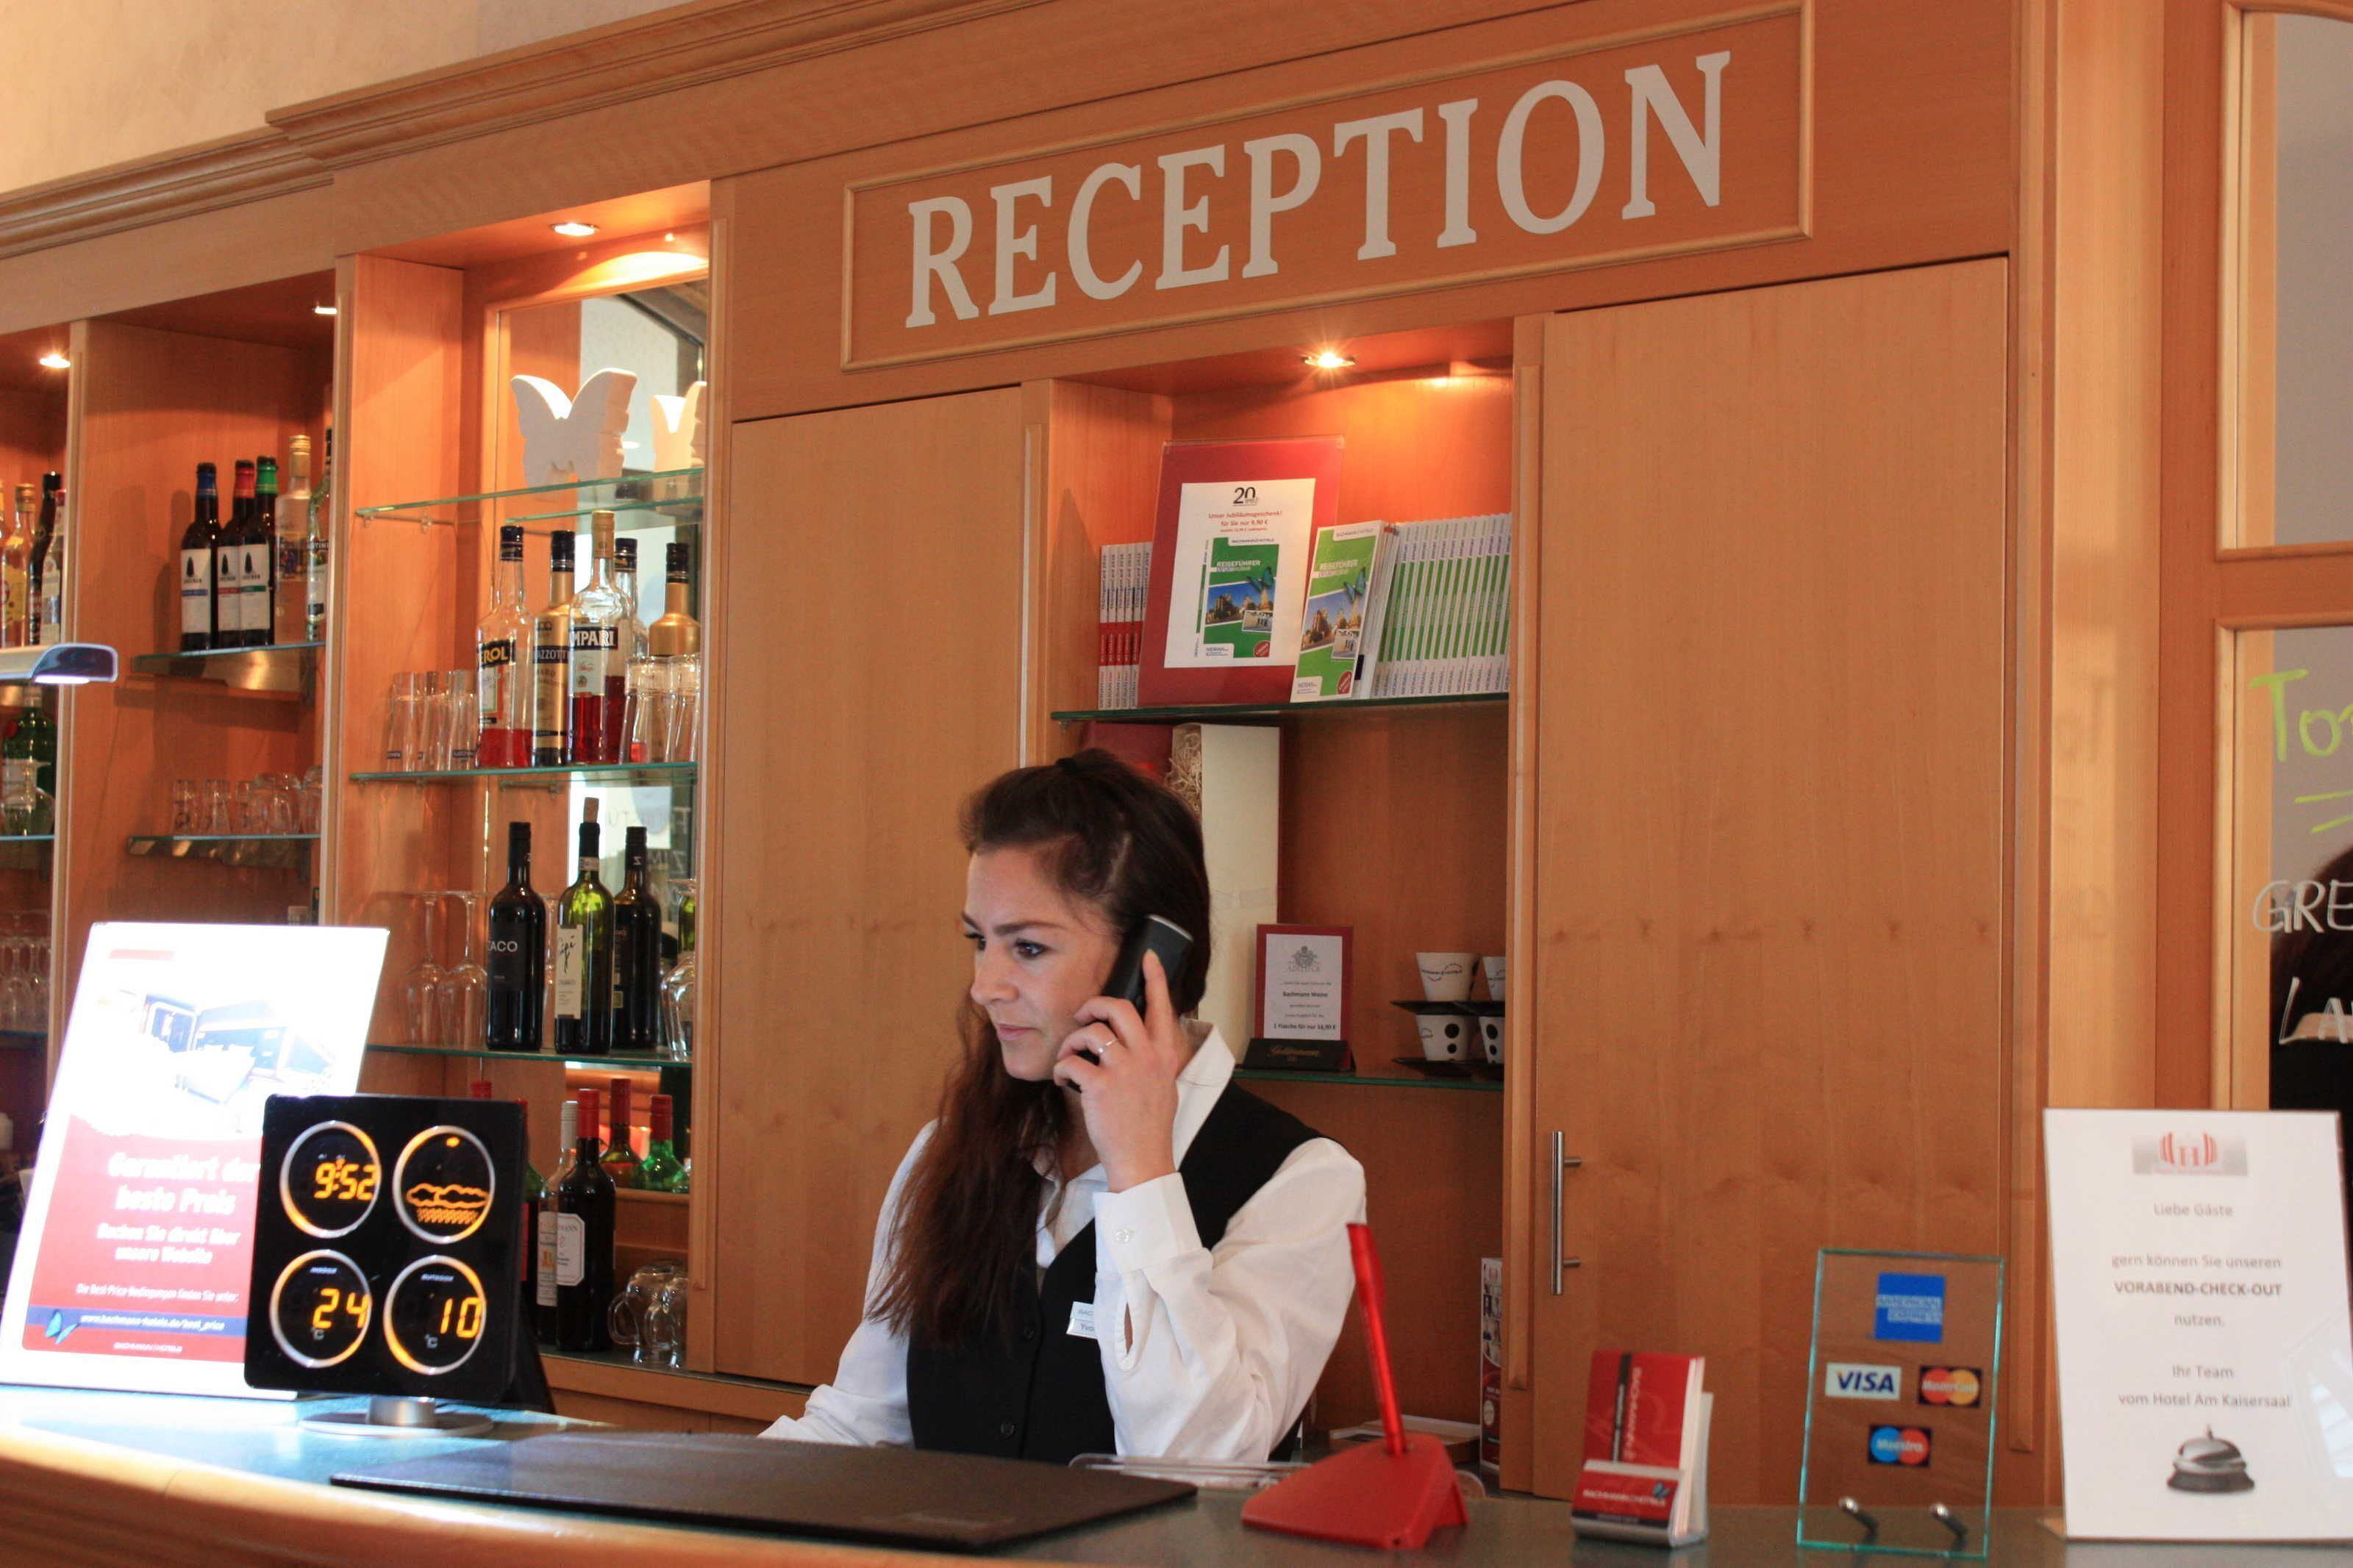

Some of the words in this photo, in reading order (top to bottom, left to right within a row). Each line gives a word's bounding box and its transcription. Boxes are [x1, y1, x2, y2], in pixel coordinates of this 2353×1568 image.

[905, 50, 1730, 329] RECEPTION
[1233, 486, 1256, 504] 20
[2279, 976, 2353, 1044] LA
[313, 1161, 379, 1200] 9:52
[115, 1184, 176, 1211] beste
[179, 1187, 237, 1215] Preis
[2154, 1203, 2190, 1217] Liebe
[2194, 1203, 2234, 1217] Gäste
[2112, 1256, 2142, 1270] gern
[2147, 1254, 2198, 1267] können
[2202, 1255, 2221, 1267] Sie
[2226, 1257, 2282, 1269] unseren
[76, 1283, 89, 1294] Die
[2114, 1281, 2282, 1296] VORABEND-CHECK-OUT
[313, 1288, 371, 1329] 24
[440, 1297, 482, 1339] 10
[2174, 1314, 2225, 1327] nutzen.
[2172, 1365, 2190, 1378] Ihr
[2196, 1366, 2234, 1378] Team
[1838, 1371, 1895, 1393] VISA
[1921, 1379, 1977, 1395] MasterCard
[2119, 1395, 2149, 1406] vom
[2153, 1393, 2190, 1407] Hotel
[2194, 1394, 2217, 1407] Am
[2222, 1393, 2291, 1408] Kaisersaal
[1876, 1438, 1924, 1453] Maestro
